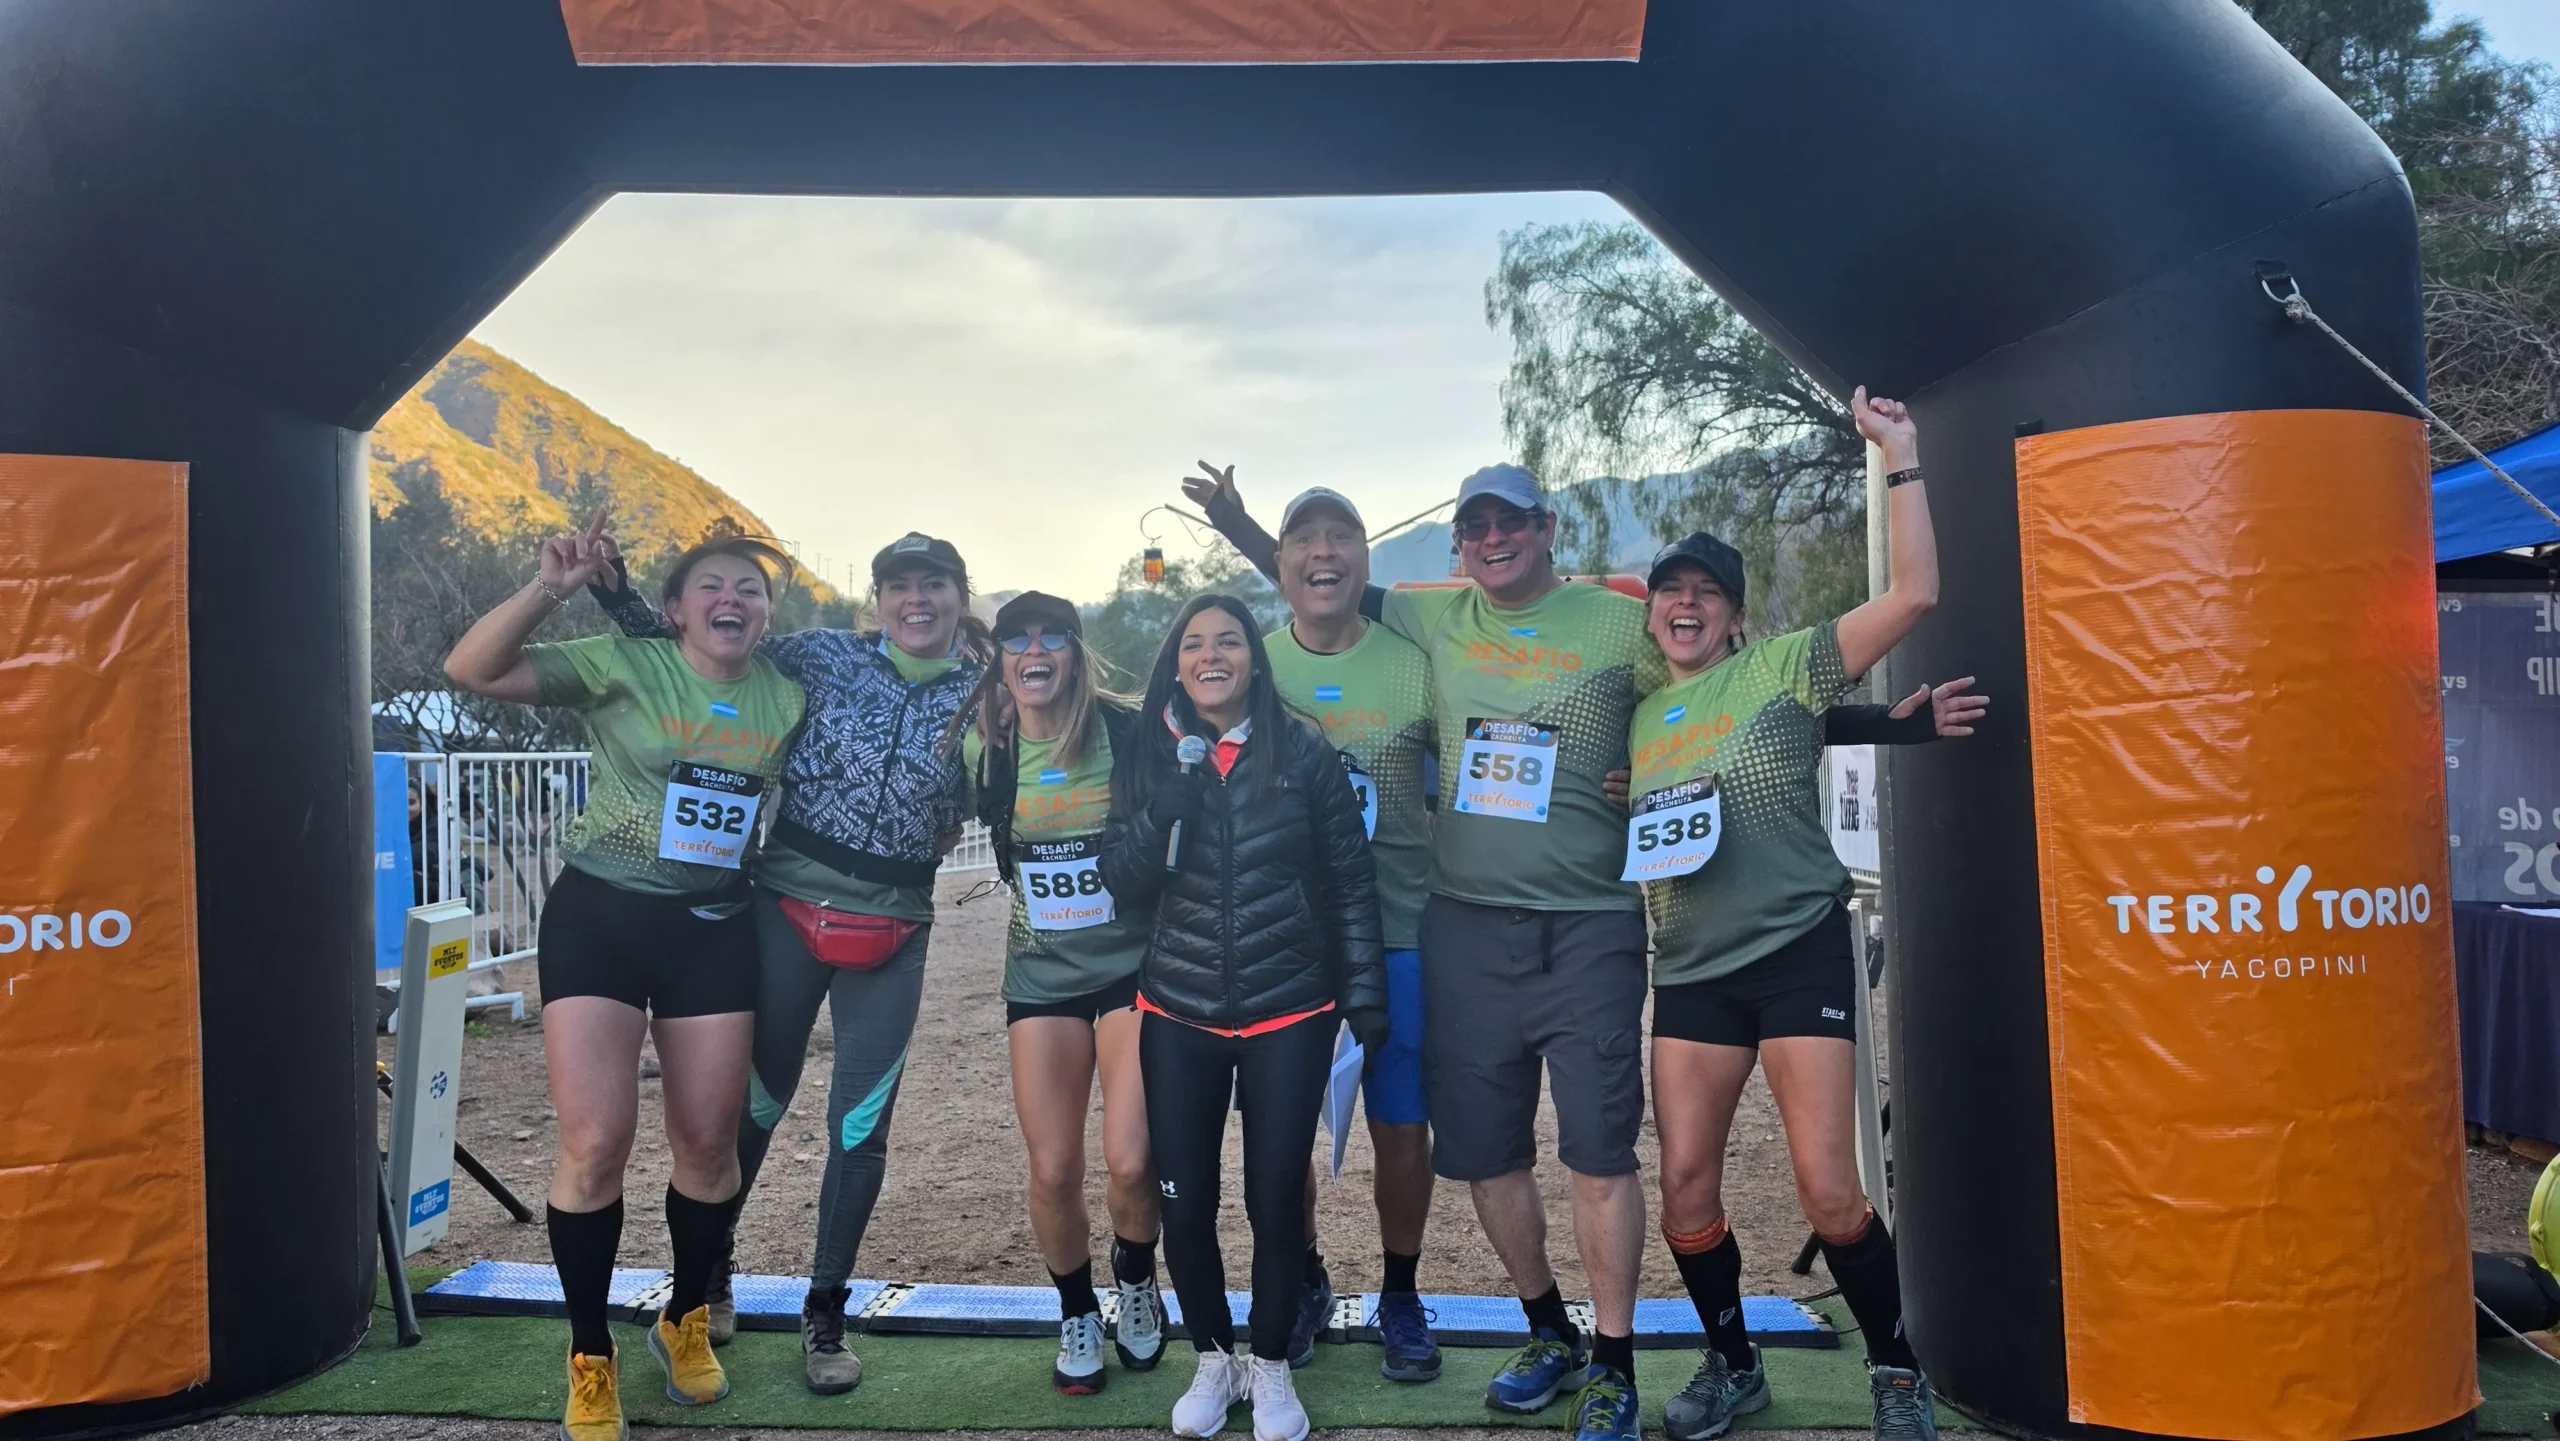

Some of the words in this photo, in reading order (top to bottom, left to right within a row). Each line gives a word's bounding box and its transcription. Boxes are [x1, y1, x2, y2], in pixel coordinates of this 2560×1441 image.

[1490, 734, 1527, 743] CACHEUTA
[1469, 752, 1543, 786] 558
[675, 797, 746, 835] 532
[1655, 796, 1693, 809] CACHEUTA
[1637, 812, 1712, 852] 538
[1041, 853, 1076, 861] CACHEUTA
[1028, 869, 1102, 899] 588
[2195, 954, 2367, 980] YACOPINI
